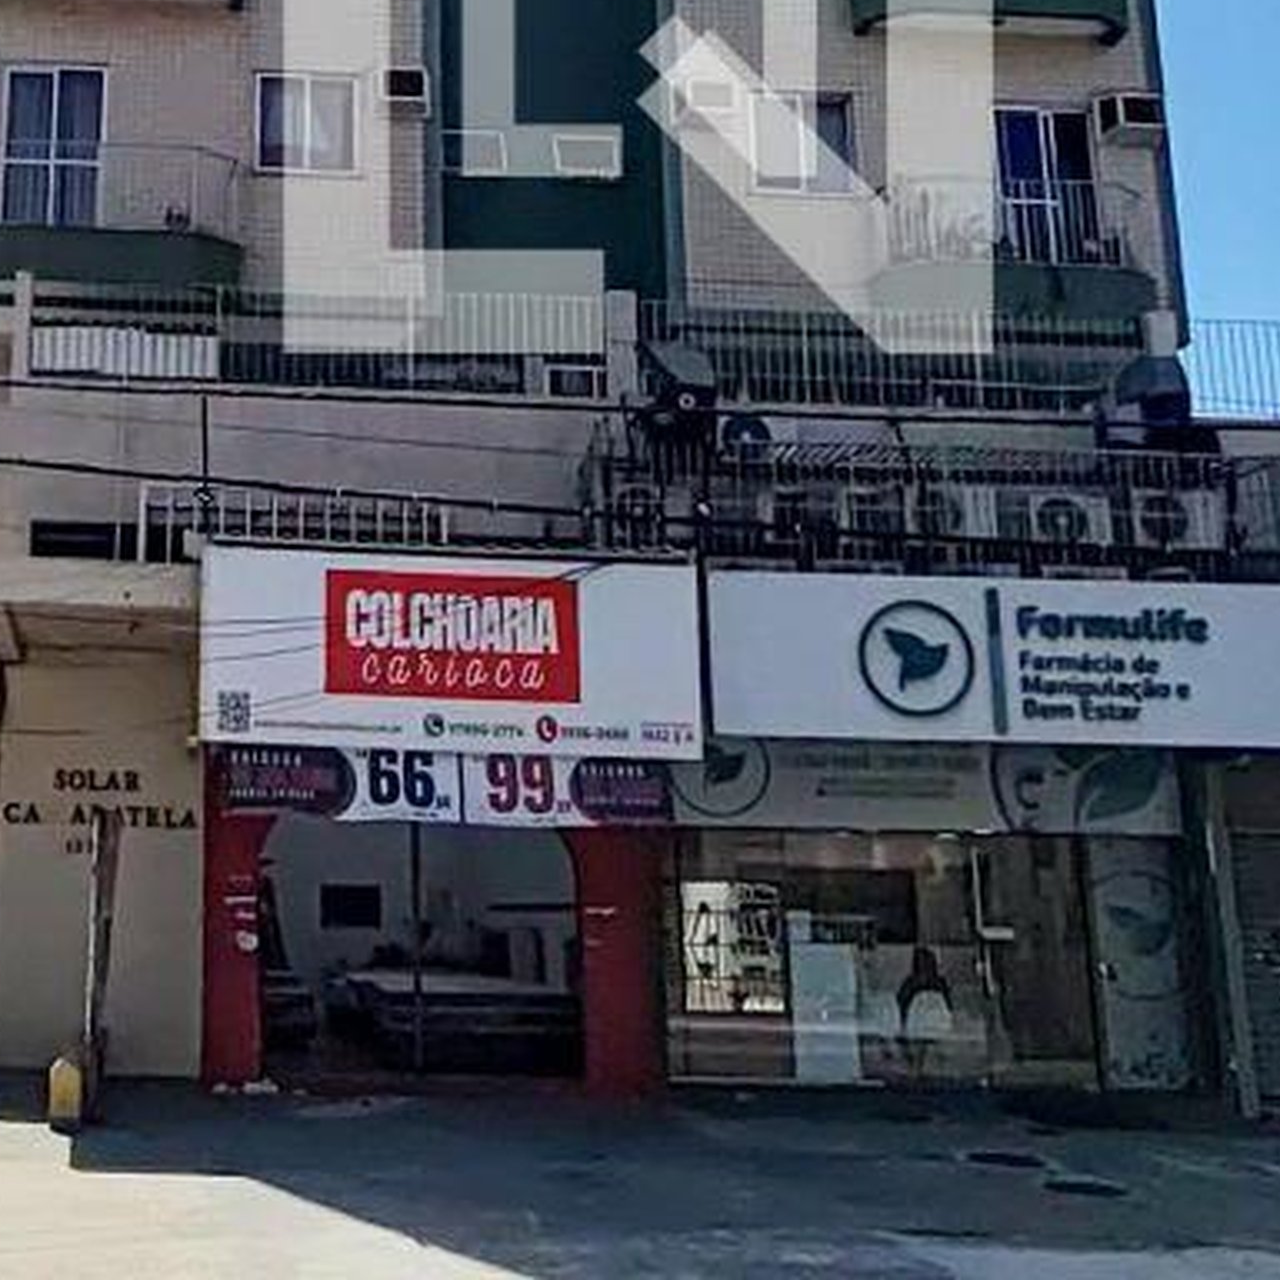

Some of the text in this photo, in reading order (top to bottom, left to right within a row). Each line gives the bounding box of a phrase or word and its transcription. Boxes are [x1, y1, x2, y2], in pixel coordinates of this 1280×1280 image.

[1016, 605, 1209, 645] Formulife
[1131, 654, 1161, 674] de
[1176, 683, 1191, 700] e
[1081, 697, 1142, 721] Estar
[53, 769, 140, 792] SOLAR
